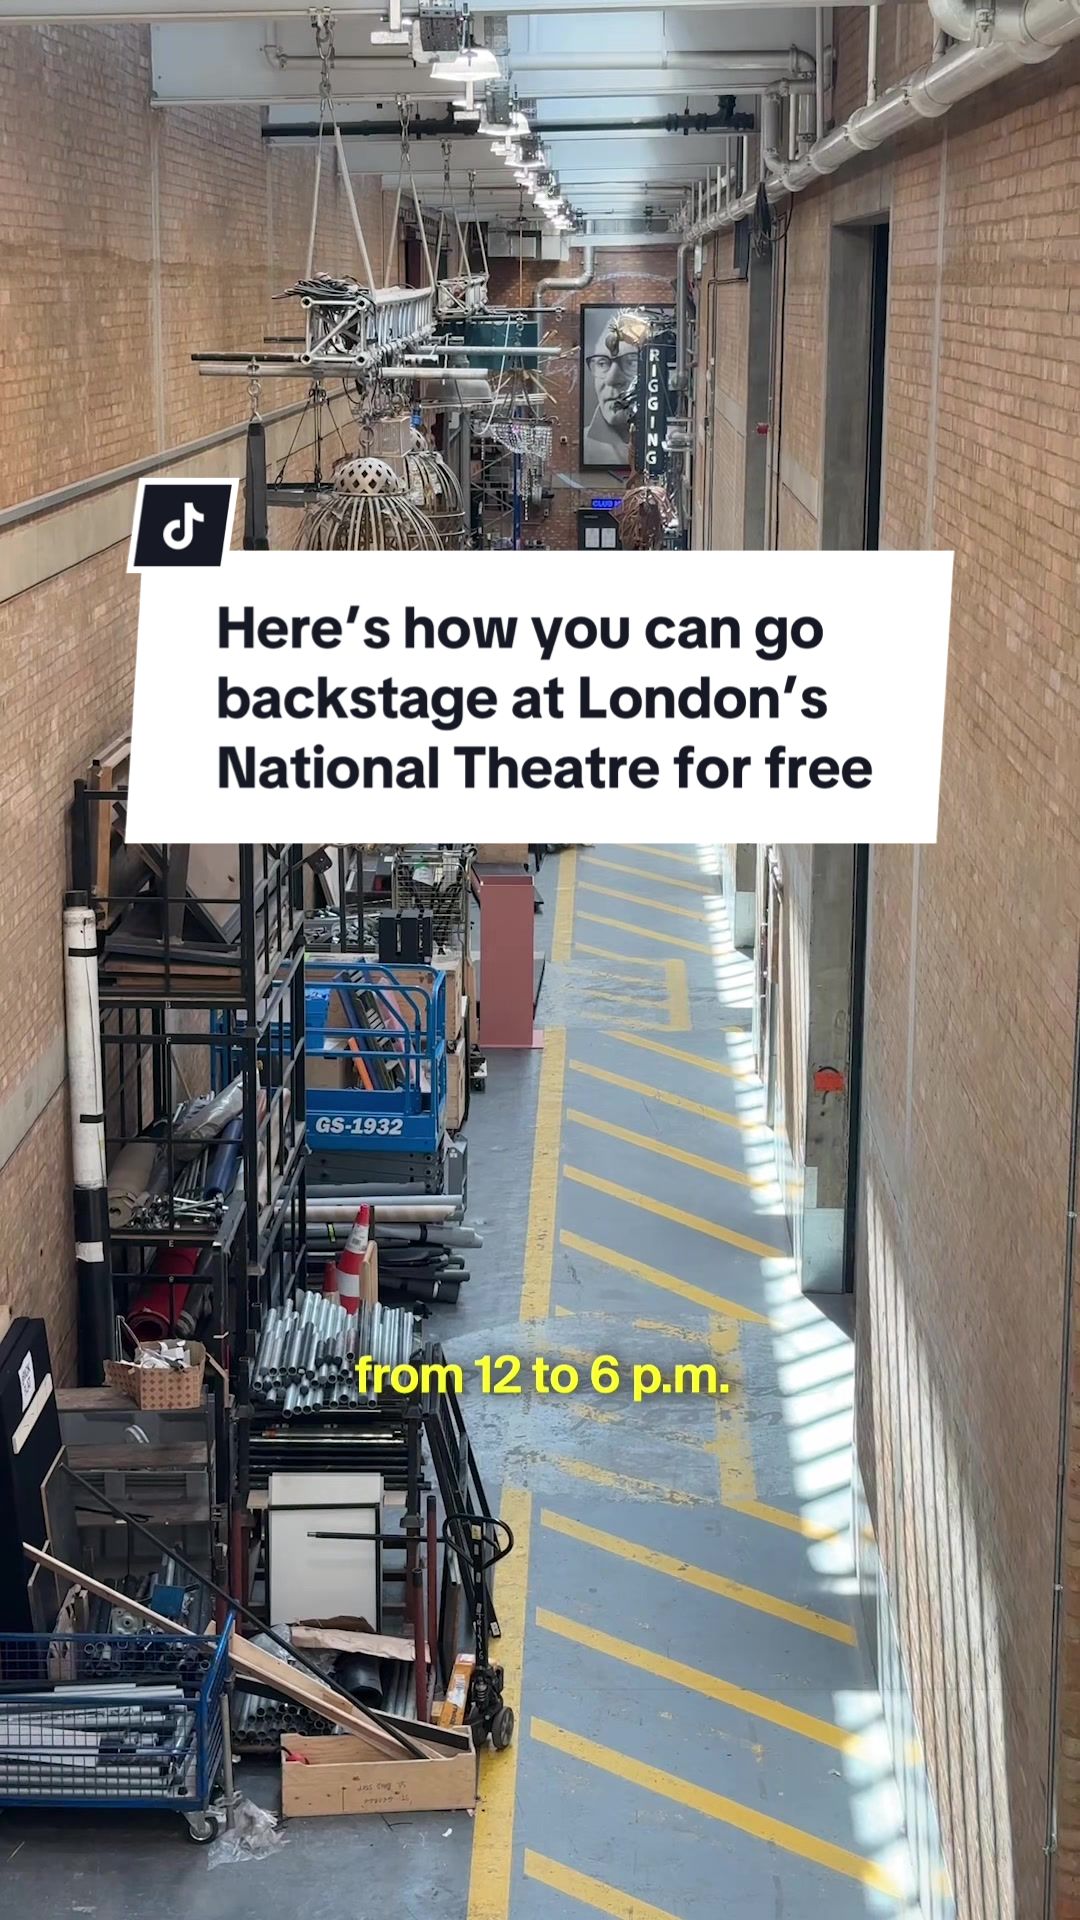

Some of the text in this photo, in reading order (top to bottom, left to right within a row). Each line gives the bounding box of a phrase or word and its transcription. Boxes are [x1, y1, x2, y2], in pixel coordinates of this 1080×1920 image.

[645, 348, 660, 465] RIGGING
[592, 500, 613, 508] CLUB
[315, 1116, 404, 1136] GS-1932
